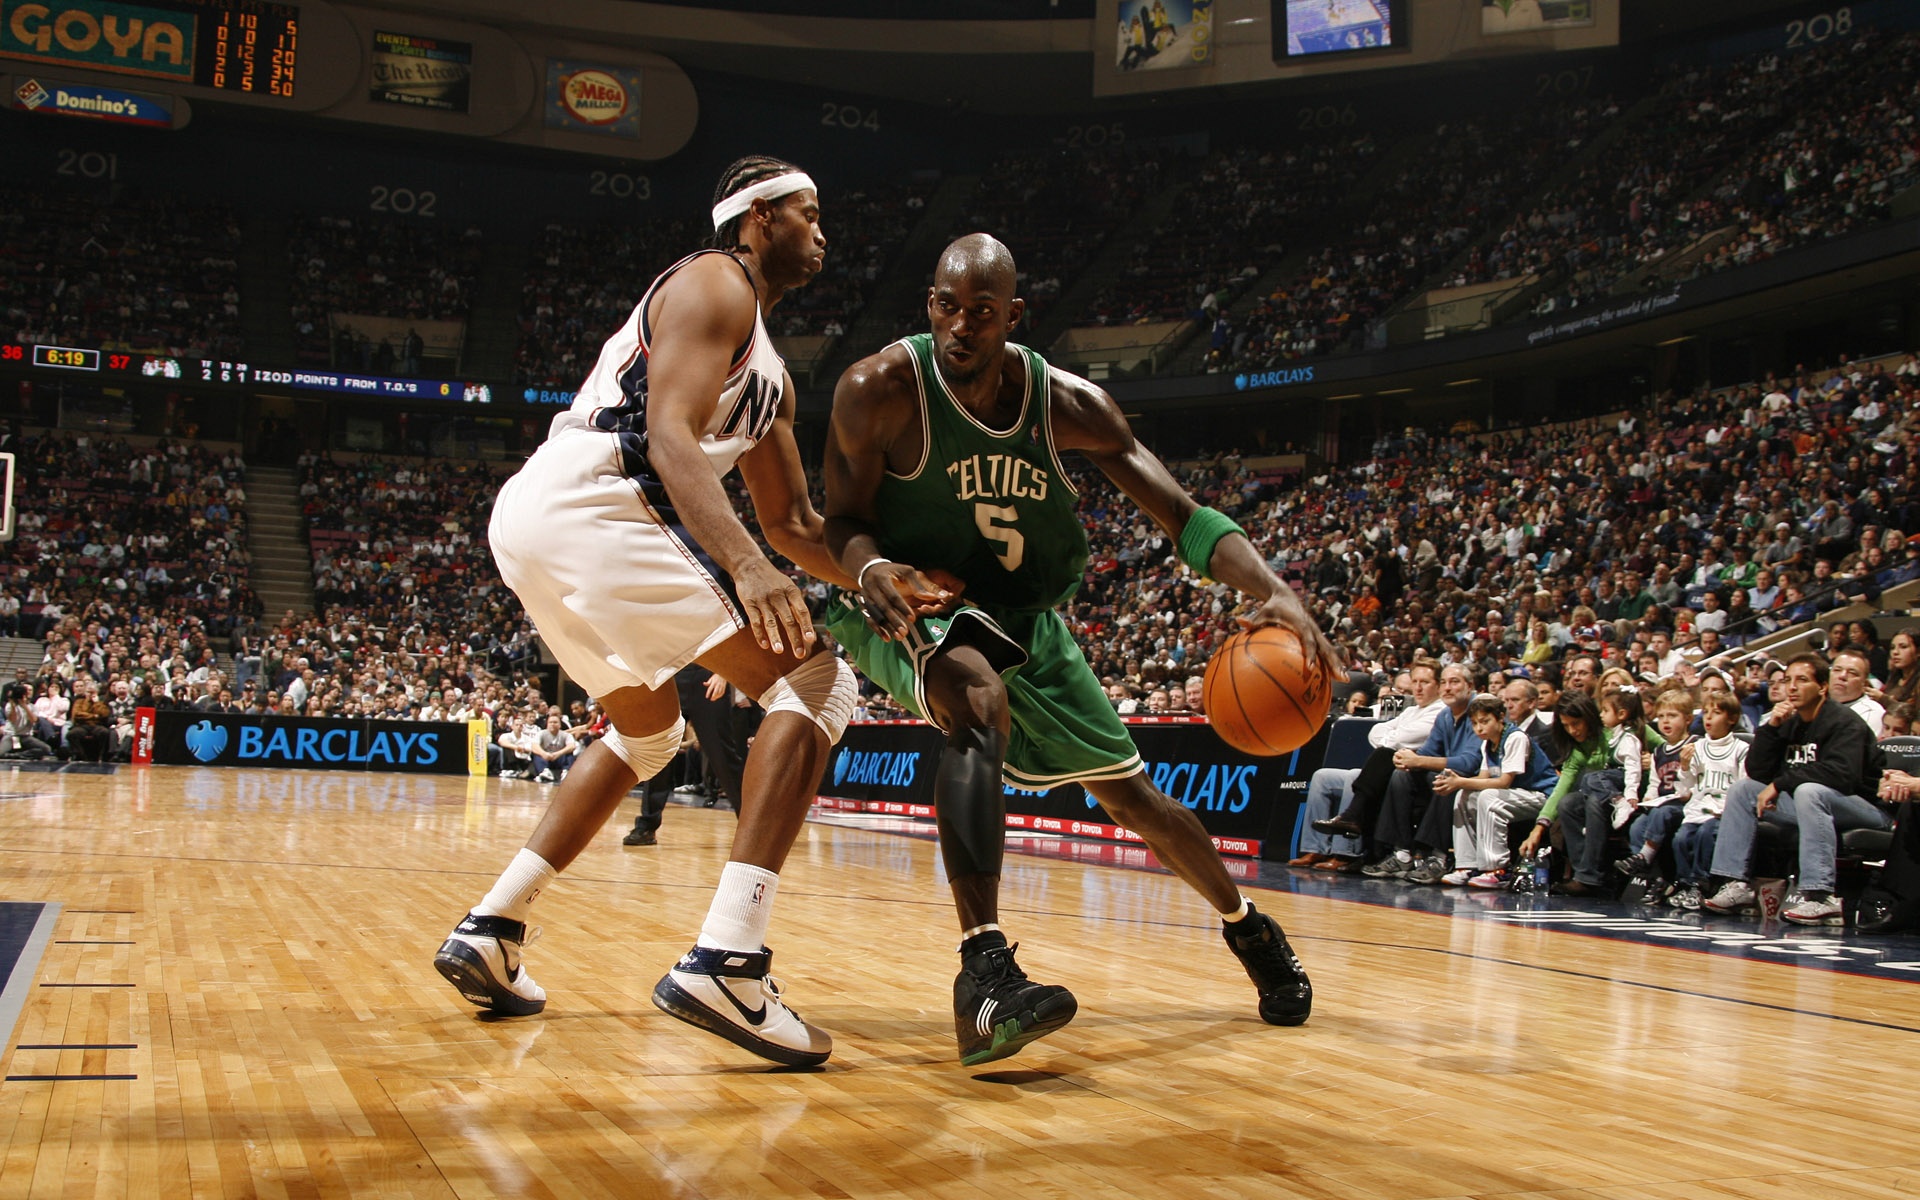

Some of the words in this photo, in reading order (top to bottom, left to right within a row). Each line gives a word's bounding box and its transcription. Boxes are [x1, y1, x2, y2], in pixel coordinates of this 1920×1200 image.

[9, 3, 184, 65] GOYA
[376, 32, 411, 46] EVENTS
[1785, 6, 1853, 48] 208
[373, 62, 413, 81] The
[1535, 65, 1595, 97] 207
[56, 89, 139, 116] Domino's
[577, 81, 622, 102] MEGA
[821, 102, 881, 132] 204
[1296, 103, 1358, 130] 206
[1066, 123, 1126, 149] 205
[56, 149, 119, 180] 201
[590, 171, 650, 200] 203
[370, 186, 437, 217] 202
[47, 349, 84, 366] 6:19
[108, 354, 130, 370] 37
[202, 369, 212, 381] 2
[220, 370, 231, 382] 5
[237, 372, 246, 384] 1
[254, 370, 293, 383] IZOD
[295, 374, 338, 386] POINTS
[344, 378, 377, 389] FROM
[440, 383, 450, 396] 6
[1250, 366, 1315, 389] BARCLAYS
[946, 454, 1048, 501] CELTICS
[974, 503, 1025, 572] 5
[238, 725, 440, 765] BARCLAYS
[847, 751, 920, 787] BARCLAYS
[1143, 762, 1258, 813] RCLAYS
[1280, 781, 1307, 789] MARQUIS
[1664, 775, 1675, 791] 5
[1042, 820, 1062, 830] TOYOTA
[1081, 824, 1103, 835] TOYOTA
[1222, 839, 1248, 851] TOYOTA
[1630, 876, 1648, 887] MA
